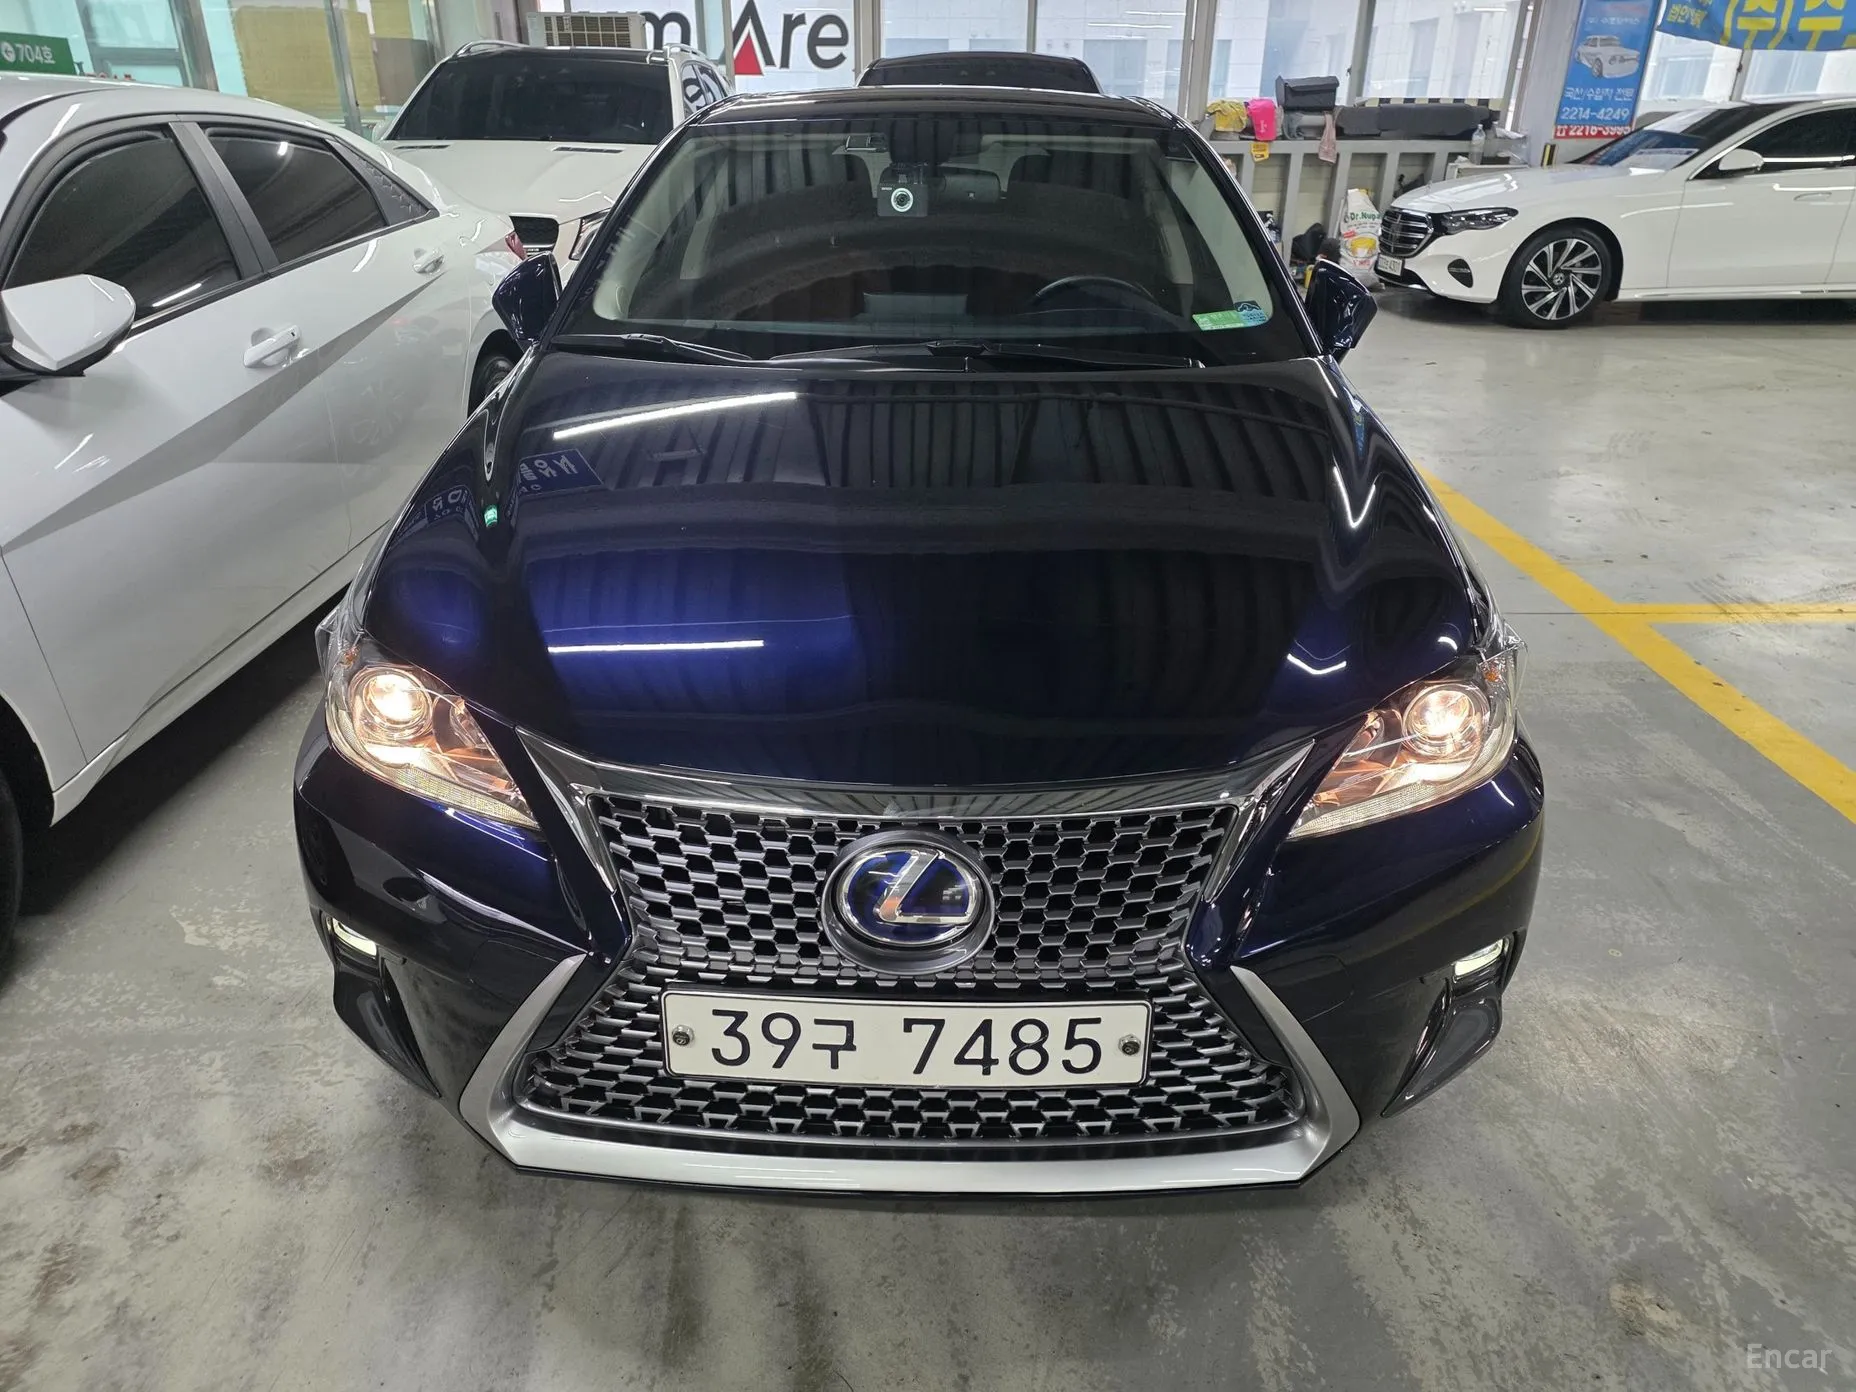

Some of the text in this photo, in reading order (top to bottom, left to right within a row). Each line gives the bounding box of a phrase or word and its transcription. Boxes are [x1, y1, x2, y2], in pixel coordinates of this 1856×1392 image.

[1561, 107, 1630, 120] 2214-4249
[711, 1008, 1103, 1076] 39구 7485
